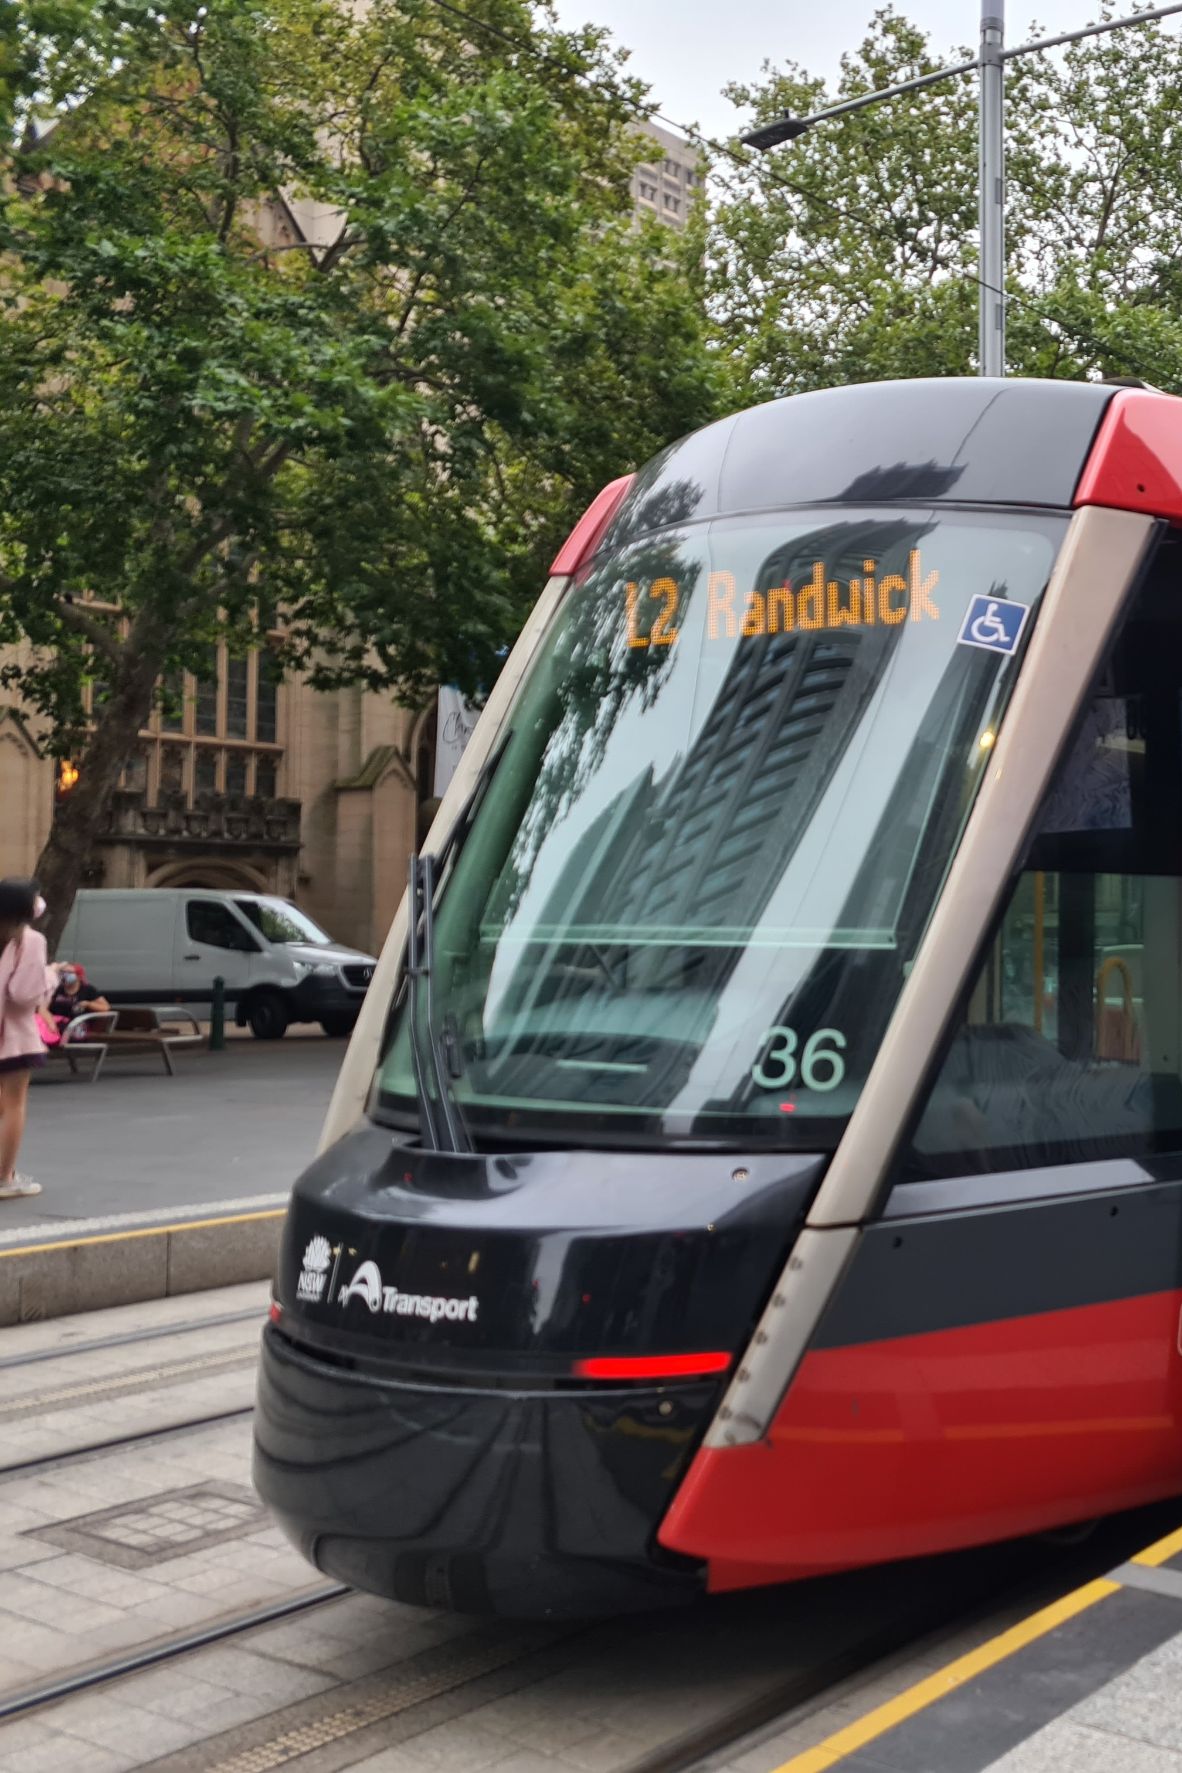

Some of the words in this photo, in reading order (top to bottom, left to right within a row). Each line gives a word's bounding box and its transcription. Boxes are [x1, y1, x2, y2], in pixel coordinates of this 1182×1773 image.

[625, 576, 679, 648] L2
[707, 548, 940, 640] Randwick
[752, 1026, 847, 1092] 36
[298, 1270, 328, 1294] NSW
[382, 1285, 479, 1324] Transport
